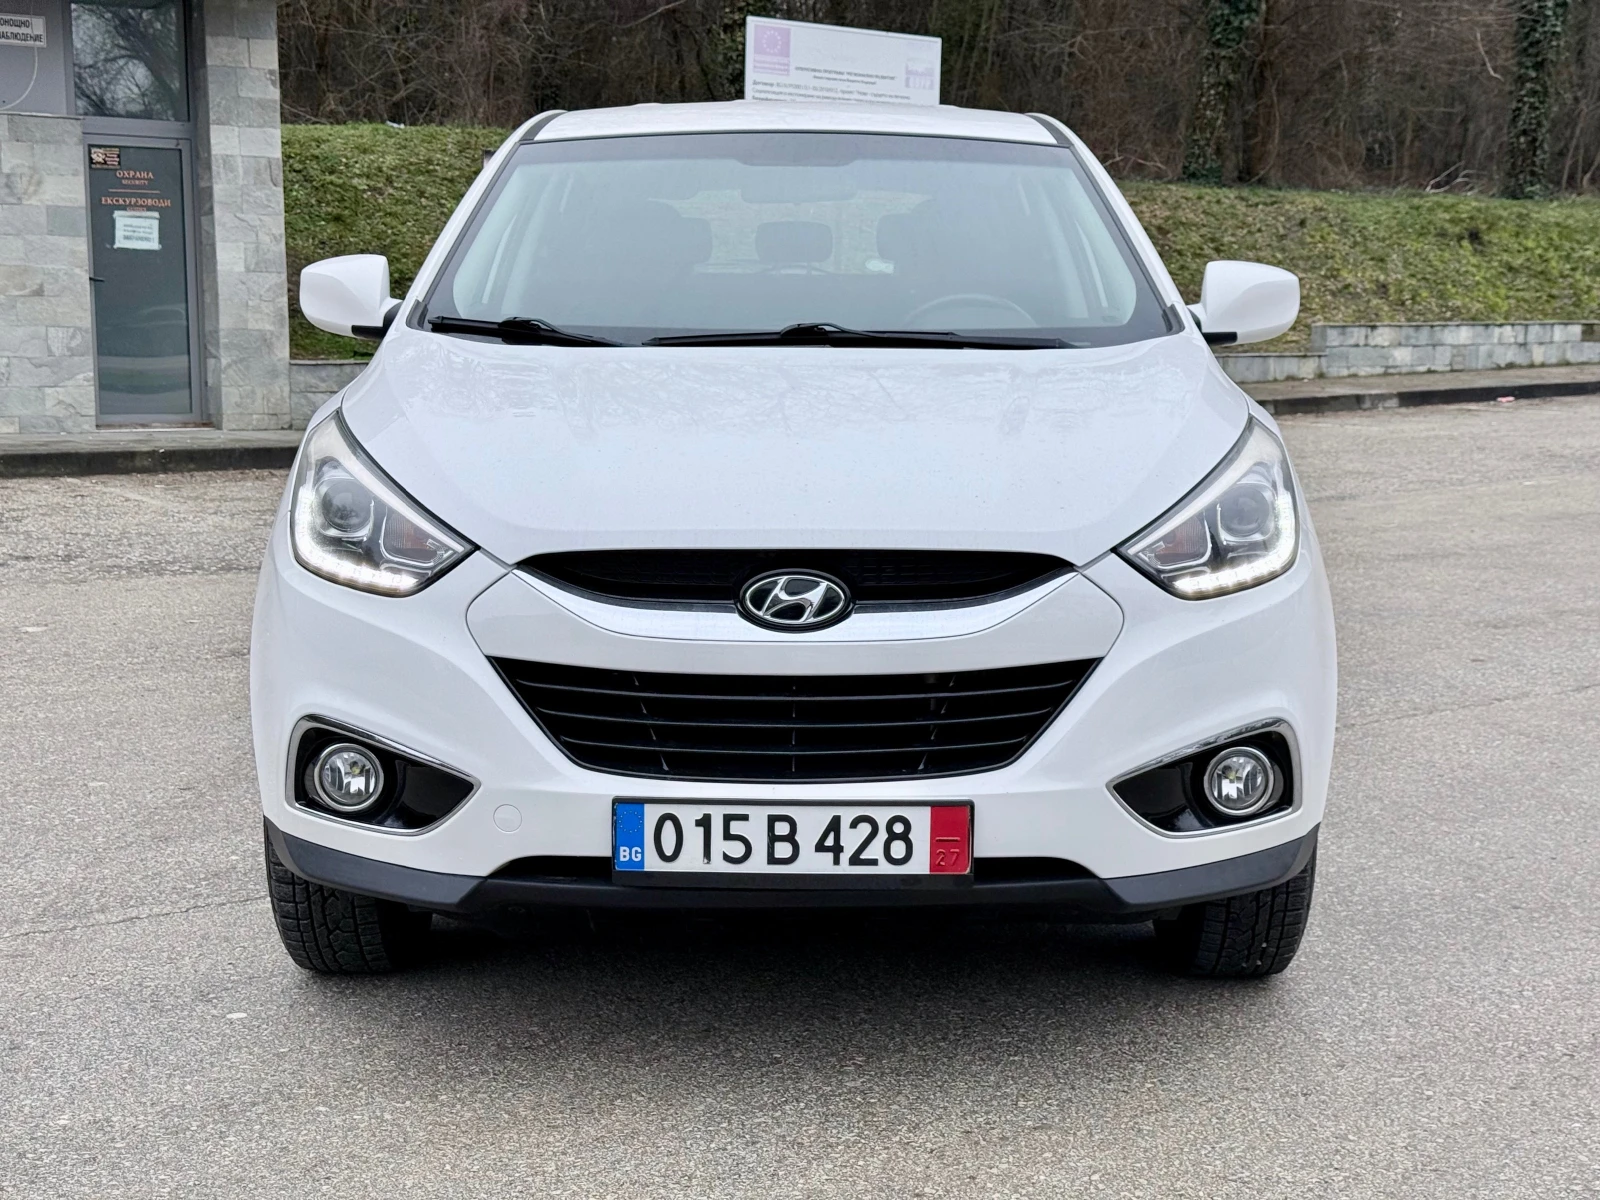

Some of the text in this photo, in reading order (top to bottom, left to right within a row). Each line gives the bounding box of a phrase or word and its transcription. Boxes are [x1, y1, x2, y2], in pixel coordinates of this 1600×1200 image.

[116, 170, 154, 179] ОХРАНА
[101, 197, 171, 207] ЕКСКУРЗОВОДИ
[653, 812, 753, 865] 015
[814, 814, 914, 867] 428
[619, 846, 642, 862] BG
[934, 849, 960, 867] 27
